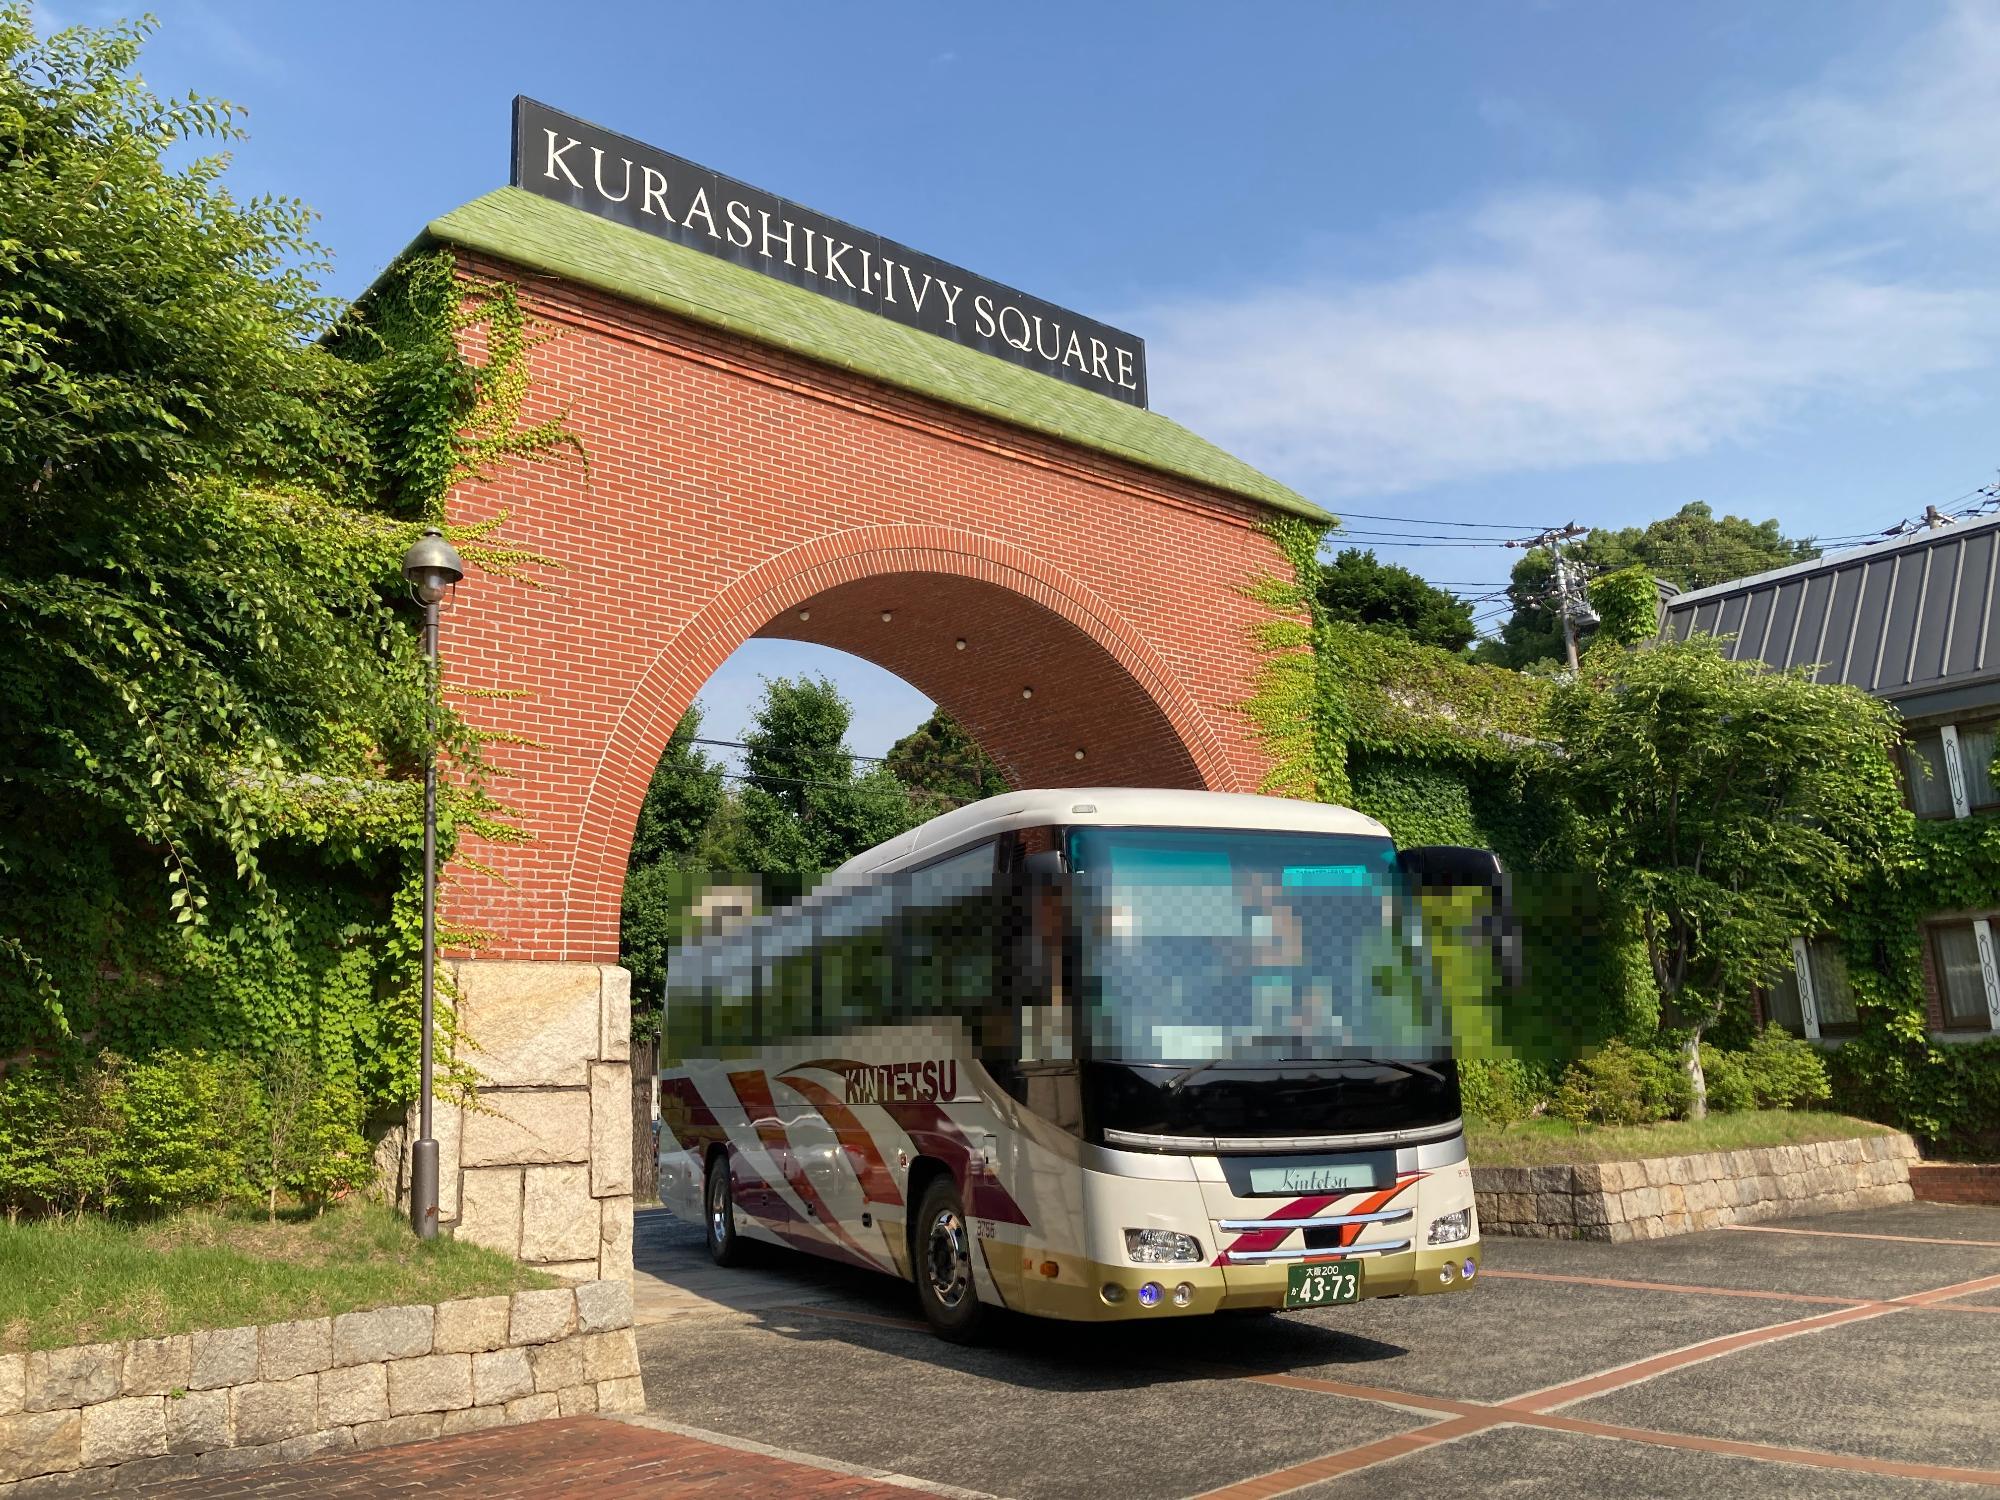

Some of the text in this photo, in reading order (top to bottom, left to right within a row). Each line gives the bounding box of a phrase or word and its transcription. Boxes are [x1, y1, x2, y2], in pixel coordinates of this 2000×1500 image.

[974, 295, 1137, 390] SQUARE
[845, 1060, 957, 1104] KINTETSU
[1280, 1168, 1348, 1191] Kintetsu
[1306, 1265, 1339, 1277] 大阪200
[1290, 1274, 1356, 1302] か 43-73
